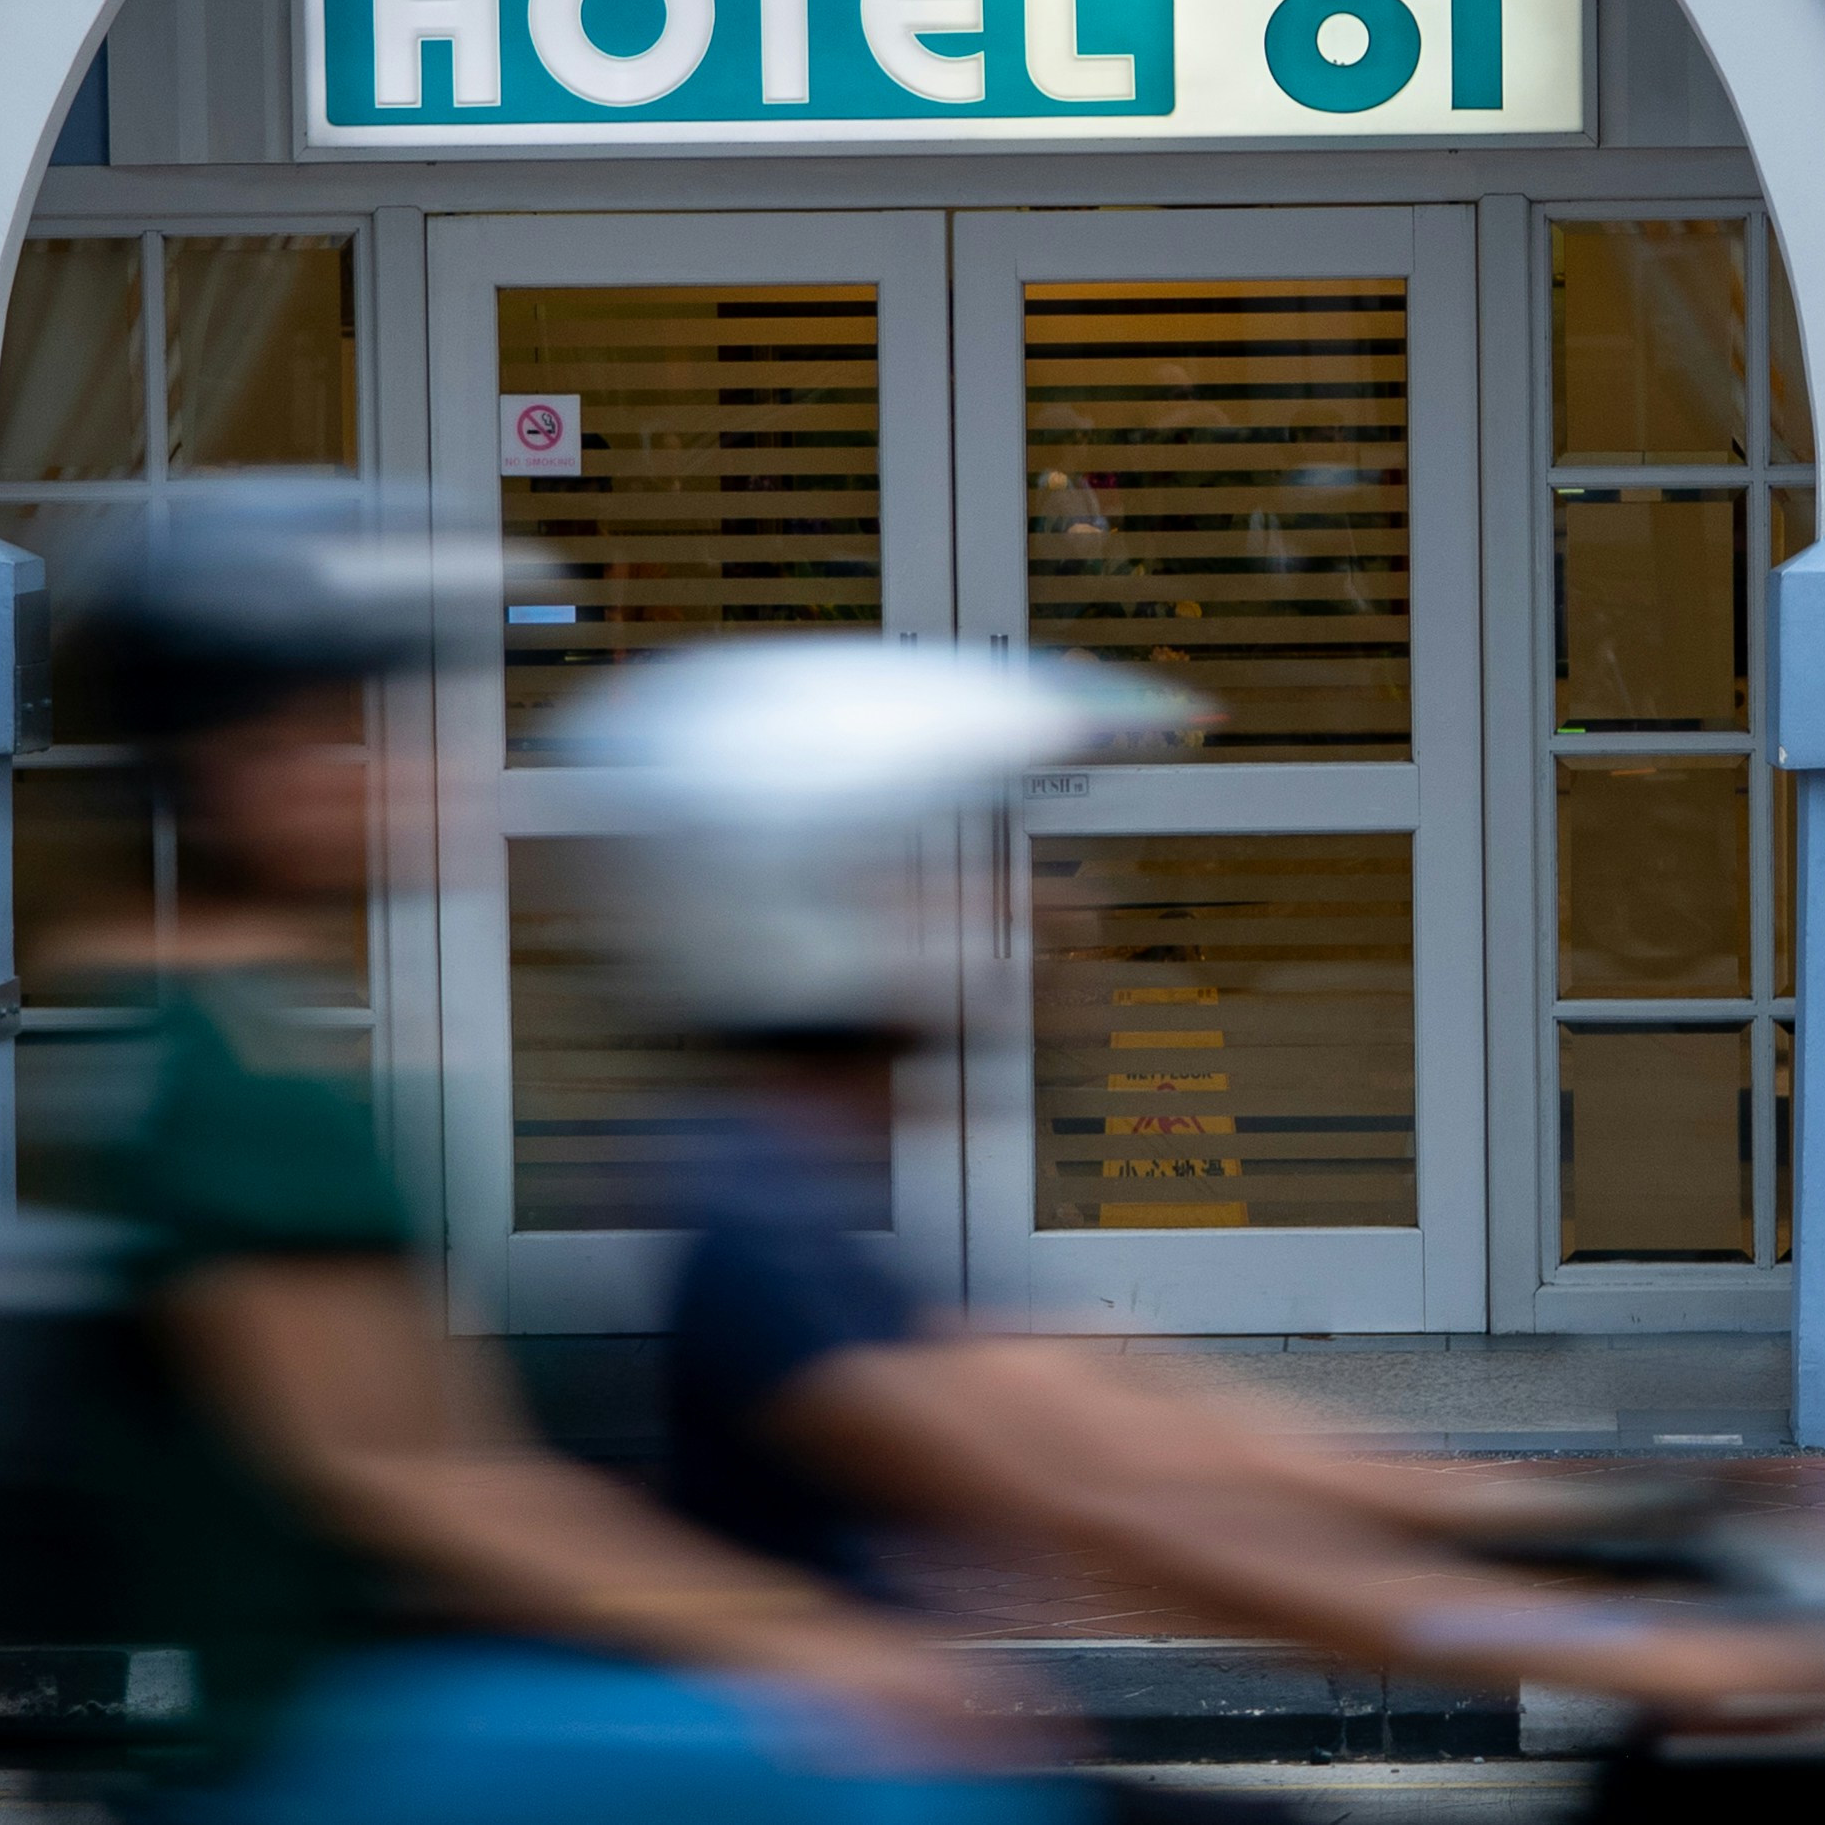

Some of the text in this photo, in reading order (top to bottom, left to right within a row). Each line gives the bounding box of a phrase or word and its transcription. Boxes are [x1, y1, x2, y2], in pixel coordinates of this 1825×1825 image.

[504, 456, 576, 467] NO SMOKING
[1031, 778, 1070, 793] PUSH
